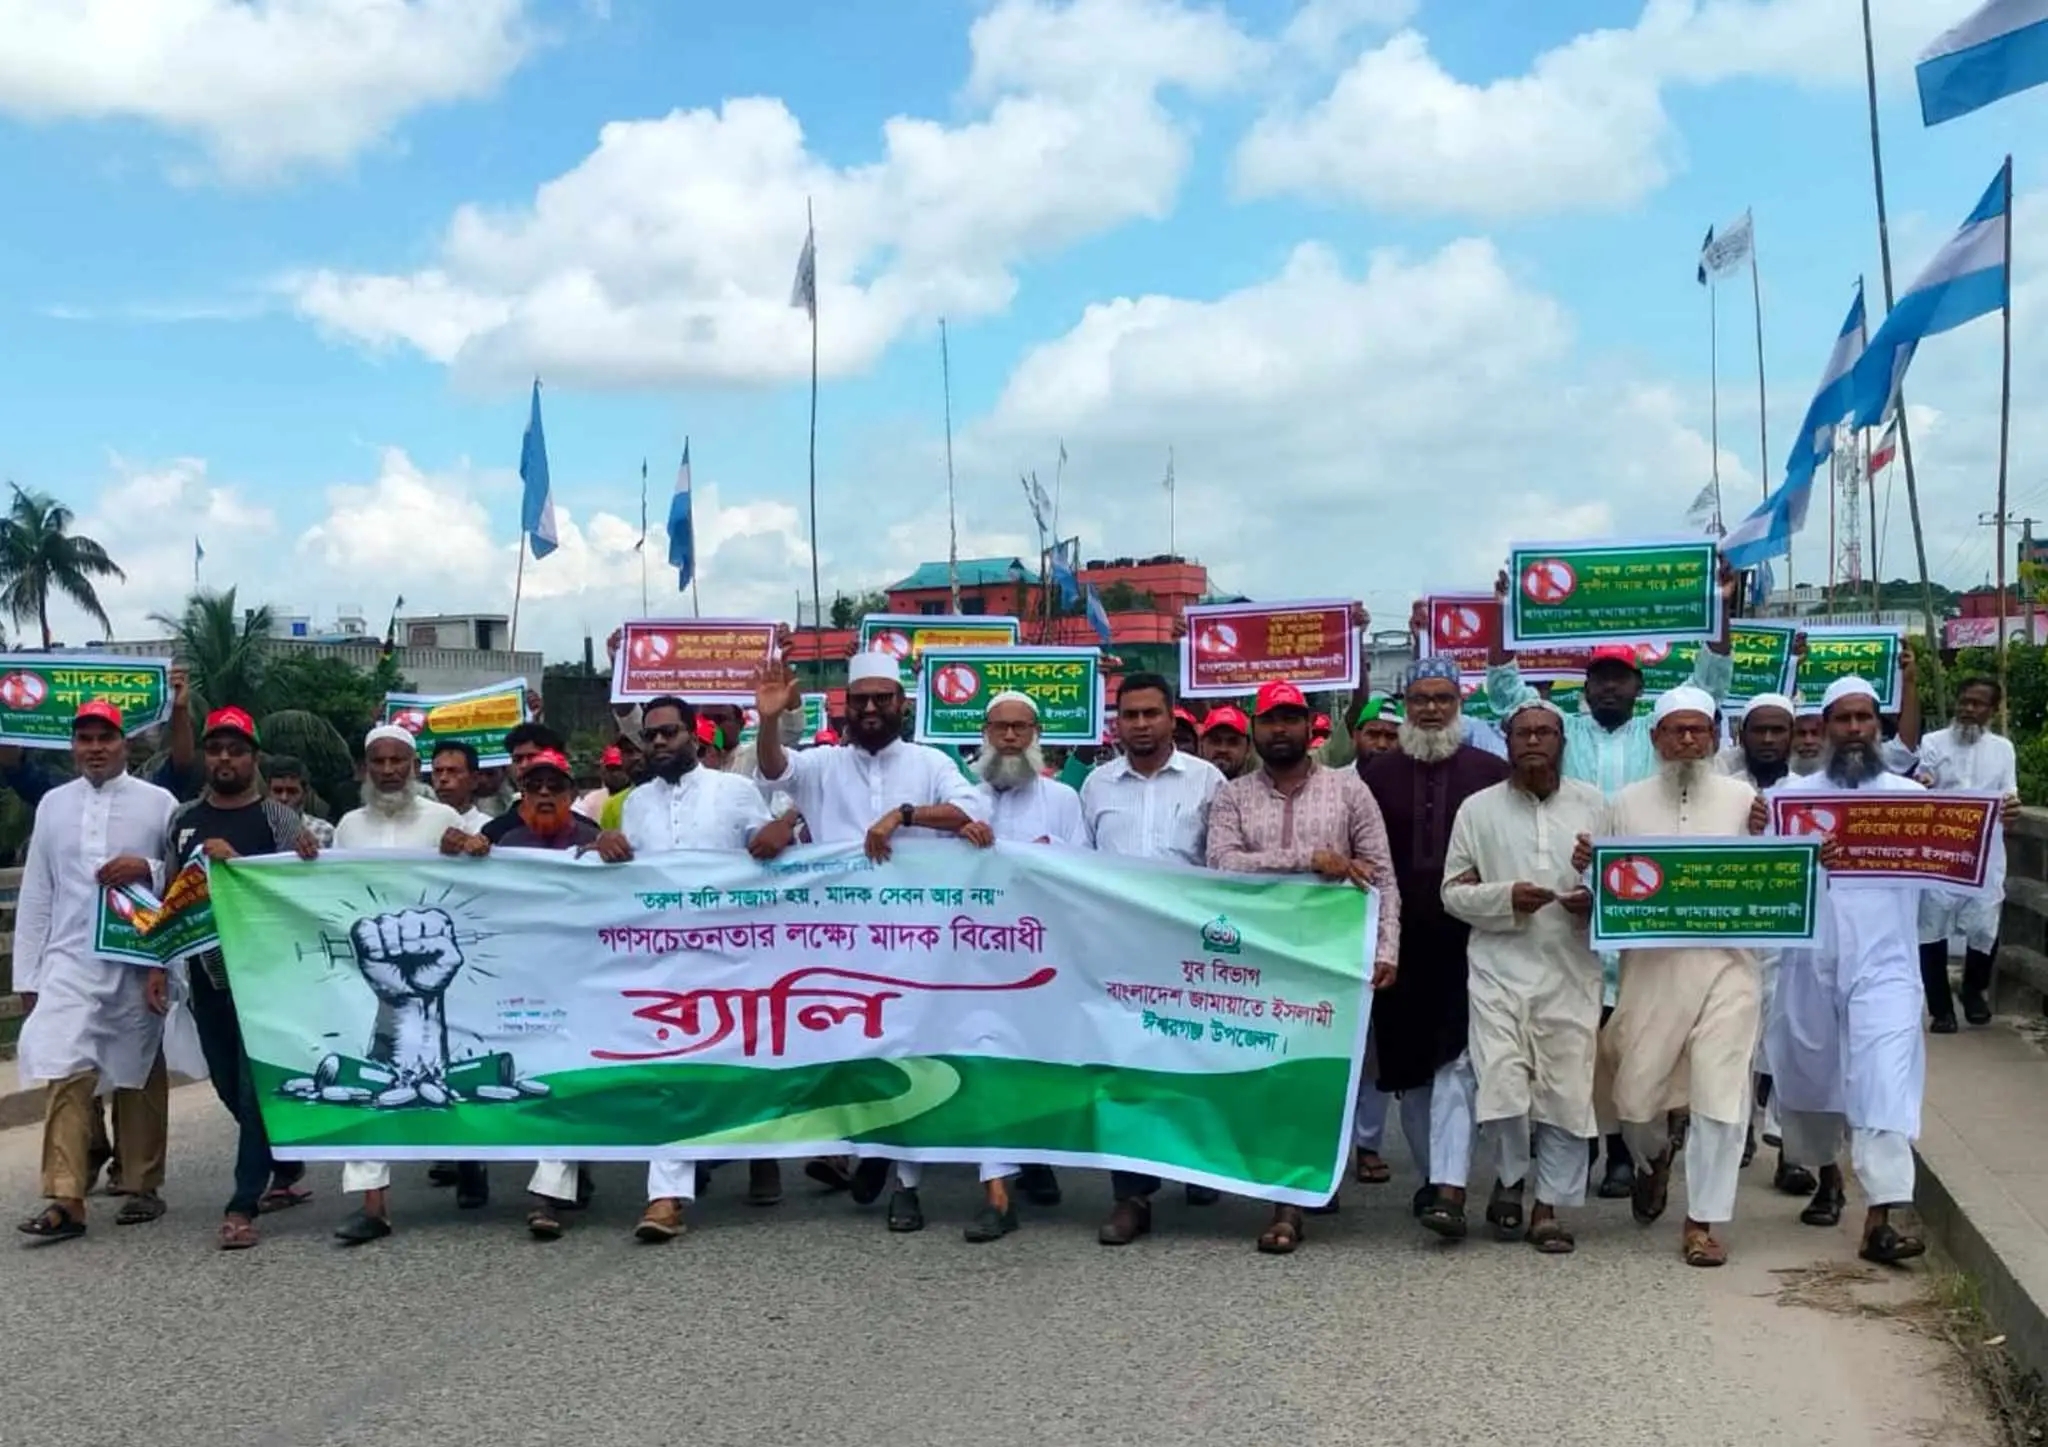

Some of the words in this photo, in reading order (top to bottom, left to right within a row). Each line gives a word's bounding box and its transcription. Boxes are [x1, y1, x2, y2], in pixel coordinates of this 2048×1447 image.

[52, 670, 156, 688] মাদককে
[983, 661, 1087, 679] মাদককে
[687, 885, 722, 909] যদি
[726, 888, 778, 908] সজাগ
[825, 886, 873, 904] মাদক
[879, 887, 925, 906] সেবন
[929, 888, 965, 907] আর
[598, 922, 778, 955] গণসচেতনতার
[785, 922, 859, 951] লক্ষ্যে
[866, 923, 941, 952] মাদক
[949, 915, 1048, 955] বিরোধী
[1180, 959, 1206, 986] যুব
[1211, 957, 1262, 988] বিভাগ
[1105, 980, 1184, 1009] বাংলাদেশ
[1187, 988, 1266, 1019] জামায়াতে
[1270, 996, 1336, 1028] ইসলামী
[1140, 1007, 1205, 1042] ঈশ্বরগঞ্জ
